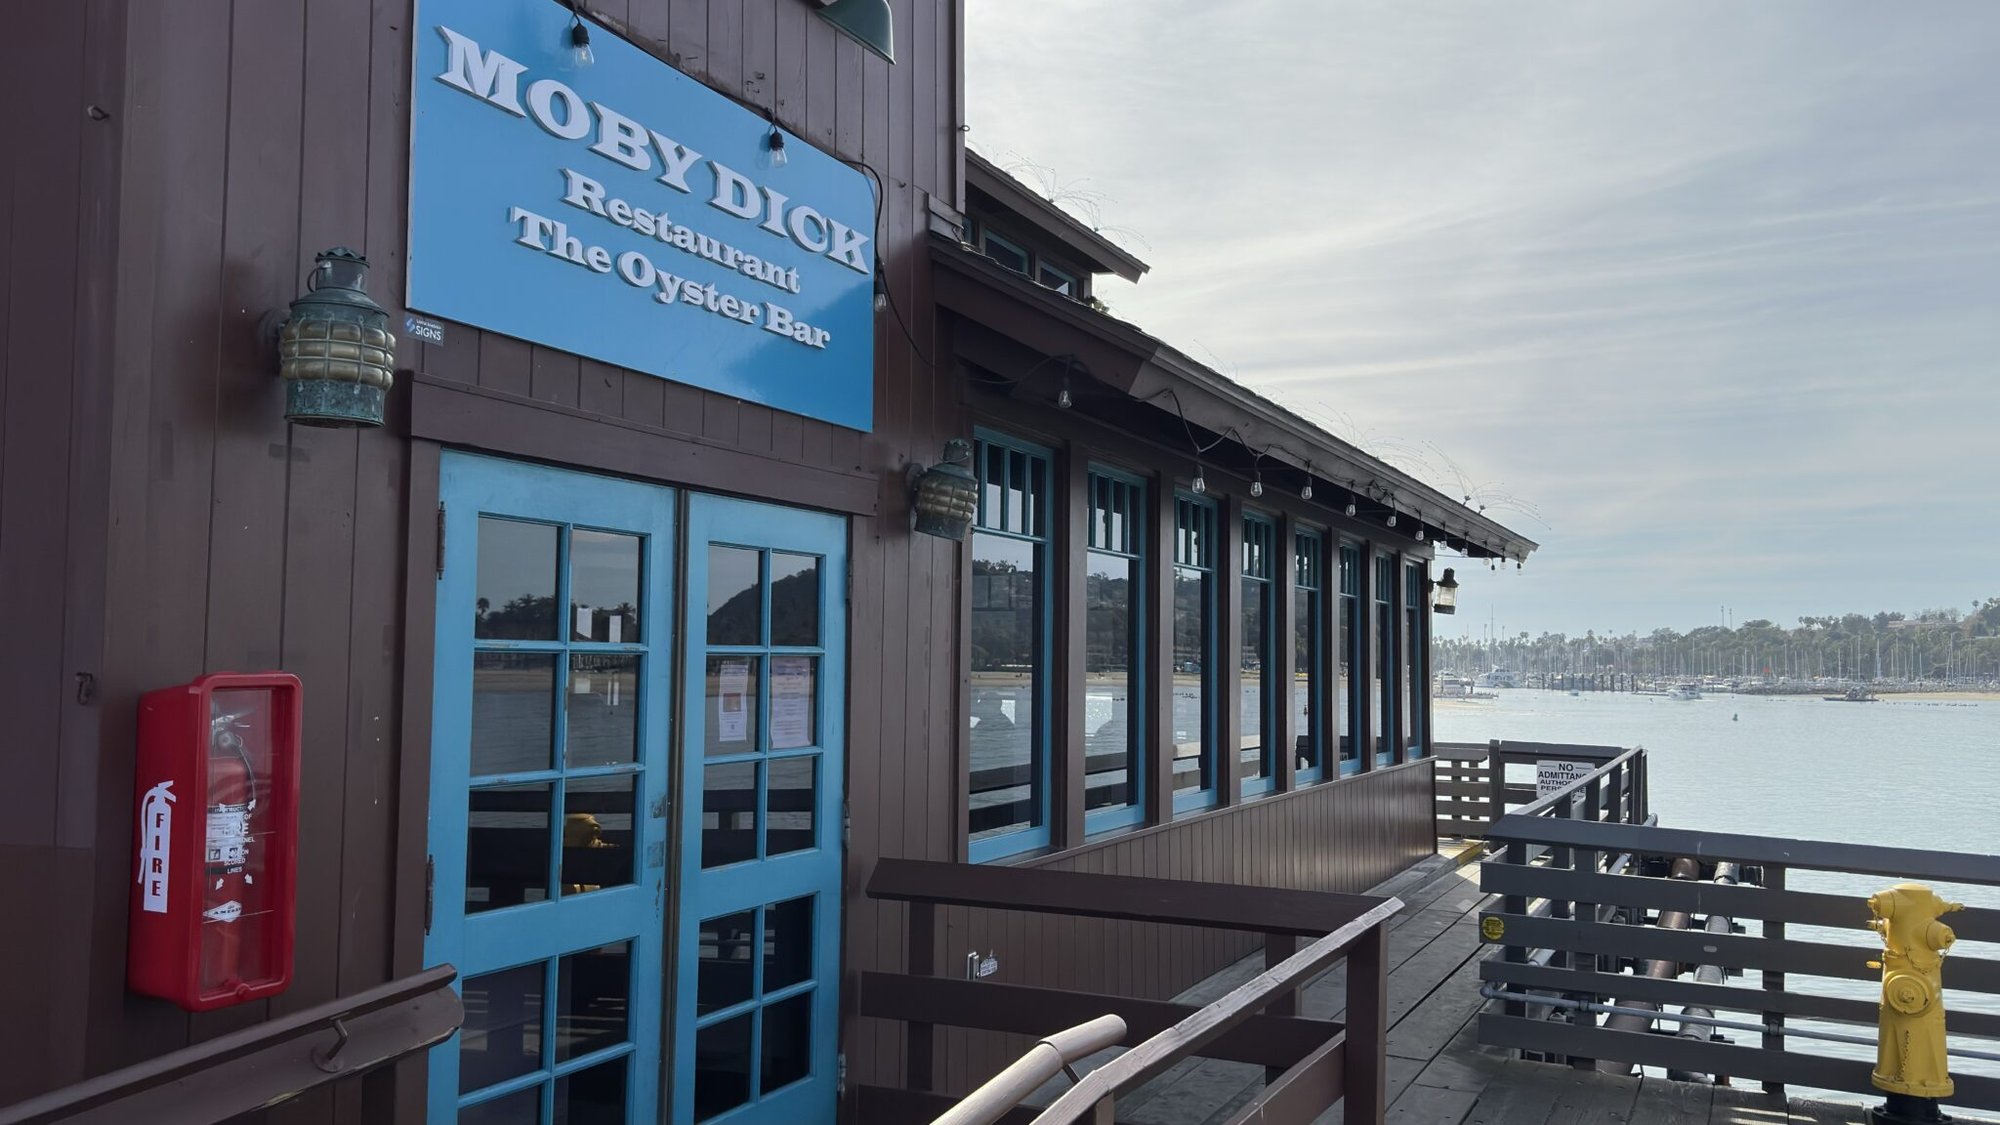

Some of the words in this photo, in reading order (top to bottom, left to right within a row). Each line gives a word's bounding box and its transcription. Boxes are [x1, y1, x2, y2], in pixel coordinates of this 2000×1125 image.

[435, 24, 702, 194] MOBY
[707, 159, 870, 275] DICK
[560, 167, 801, 294] Restaurant
[509, 206, 611, 273] The
[616, 250, 761, 325] Oyster
[762, 302, 831, 349] Bar
[415, 325, 442, 341] SIGNS
[1538, 771, 1587, 780] ADMITTAN
[1558, 763, 1574, 771] NO
[152, 813, 165, 896] FIRE
